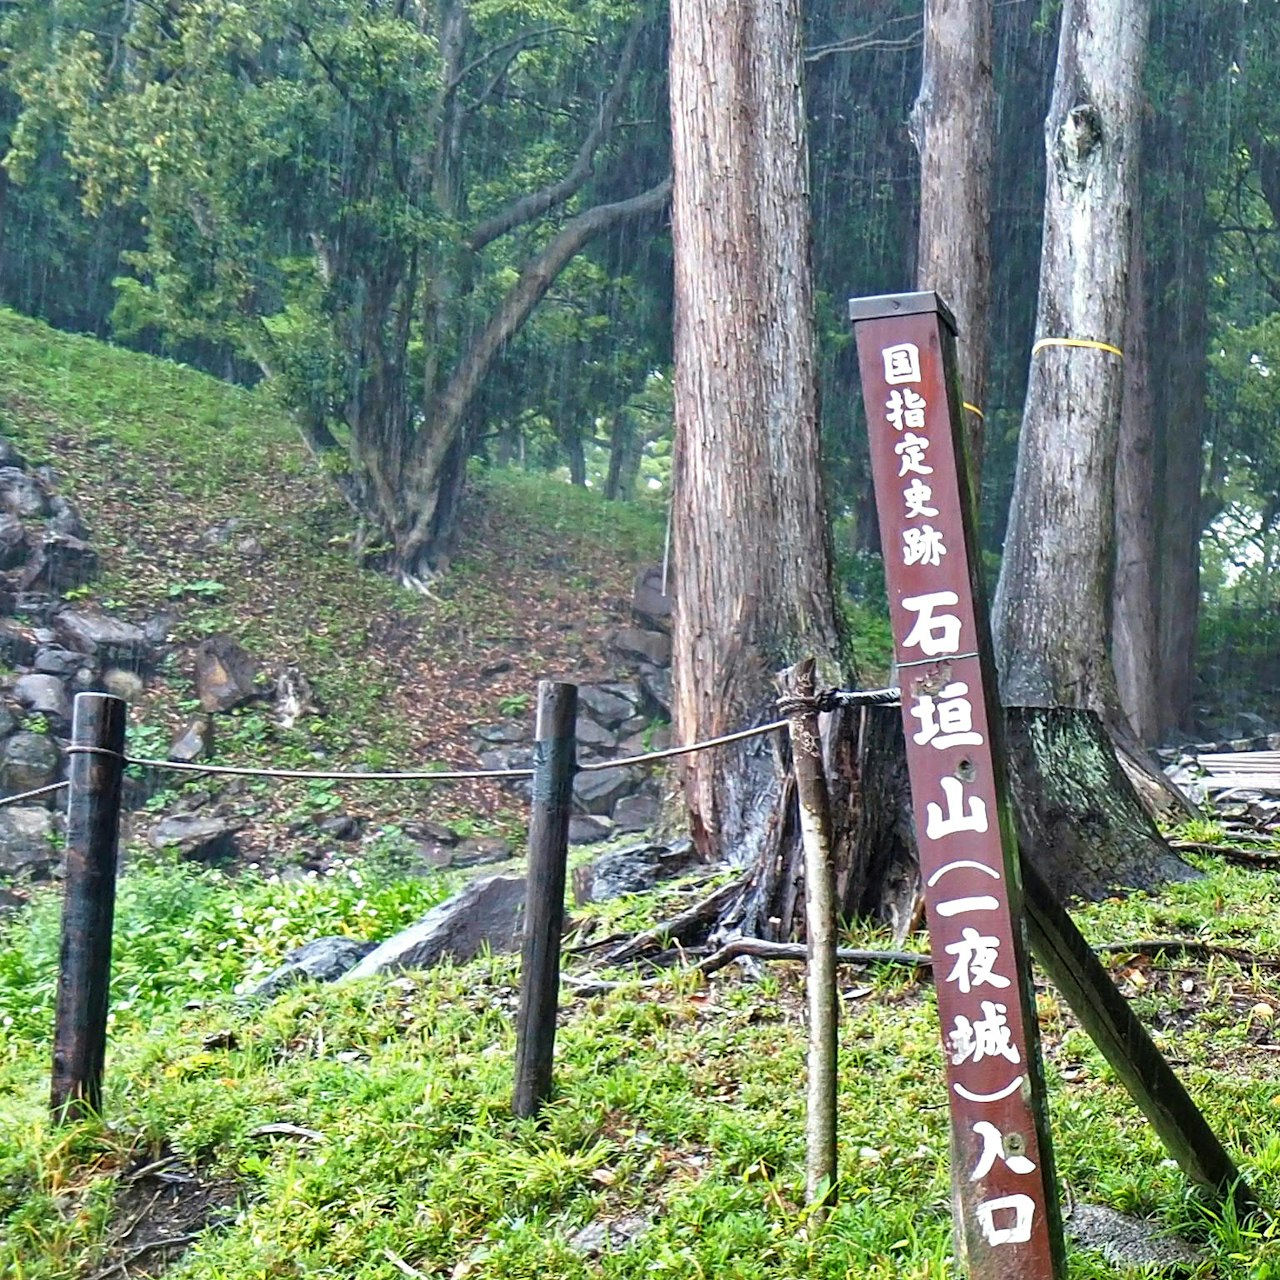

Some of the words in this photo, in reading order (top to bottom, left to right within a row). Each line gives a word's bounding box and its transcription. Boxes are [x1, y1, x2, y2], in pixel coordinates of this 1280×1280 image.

[881, 342, 947, 567] 国指定史跡
